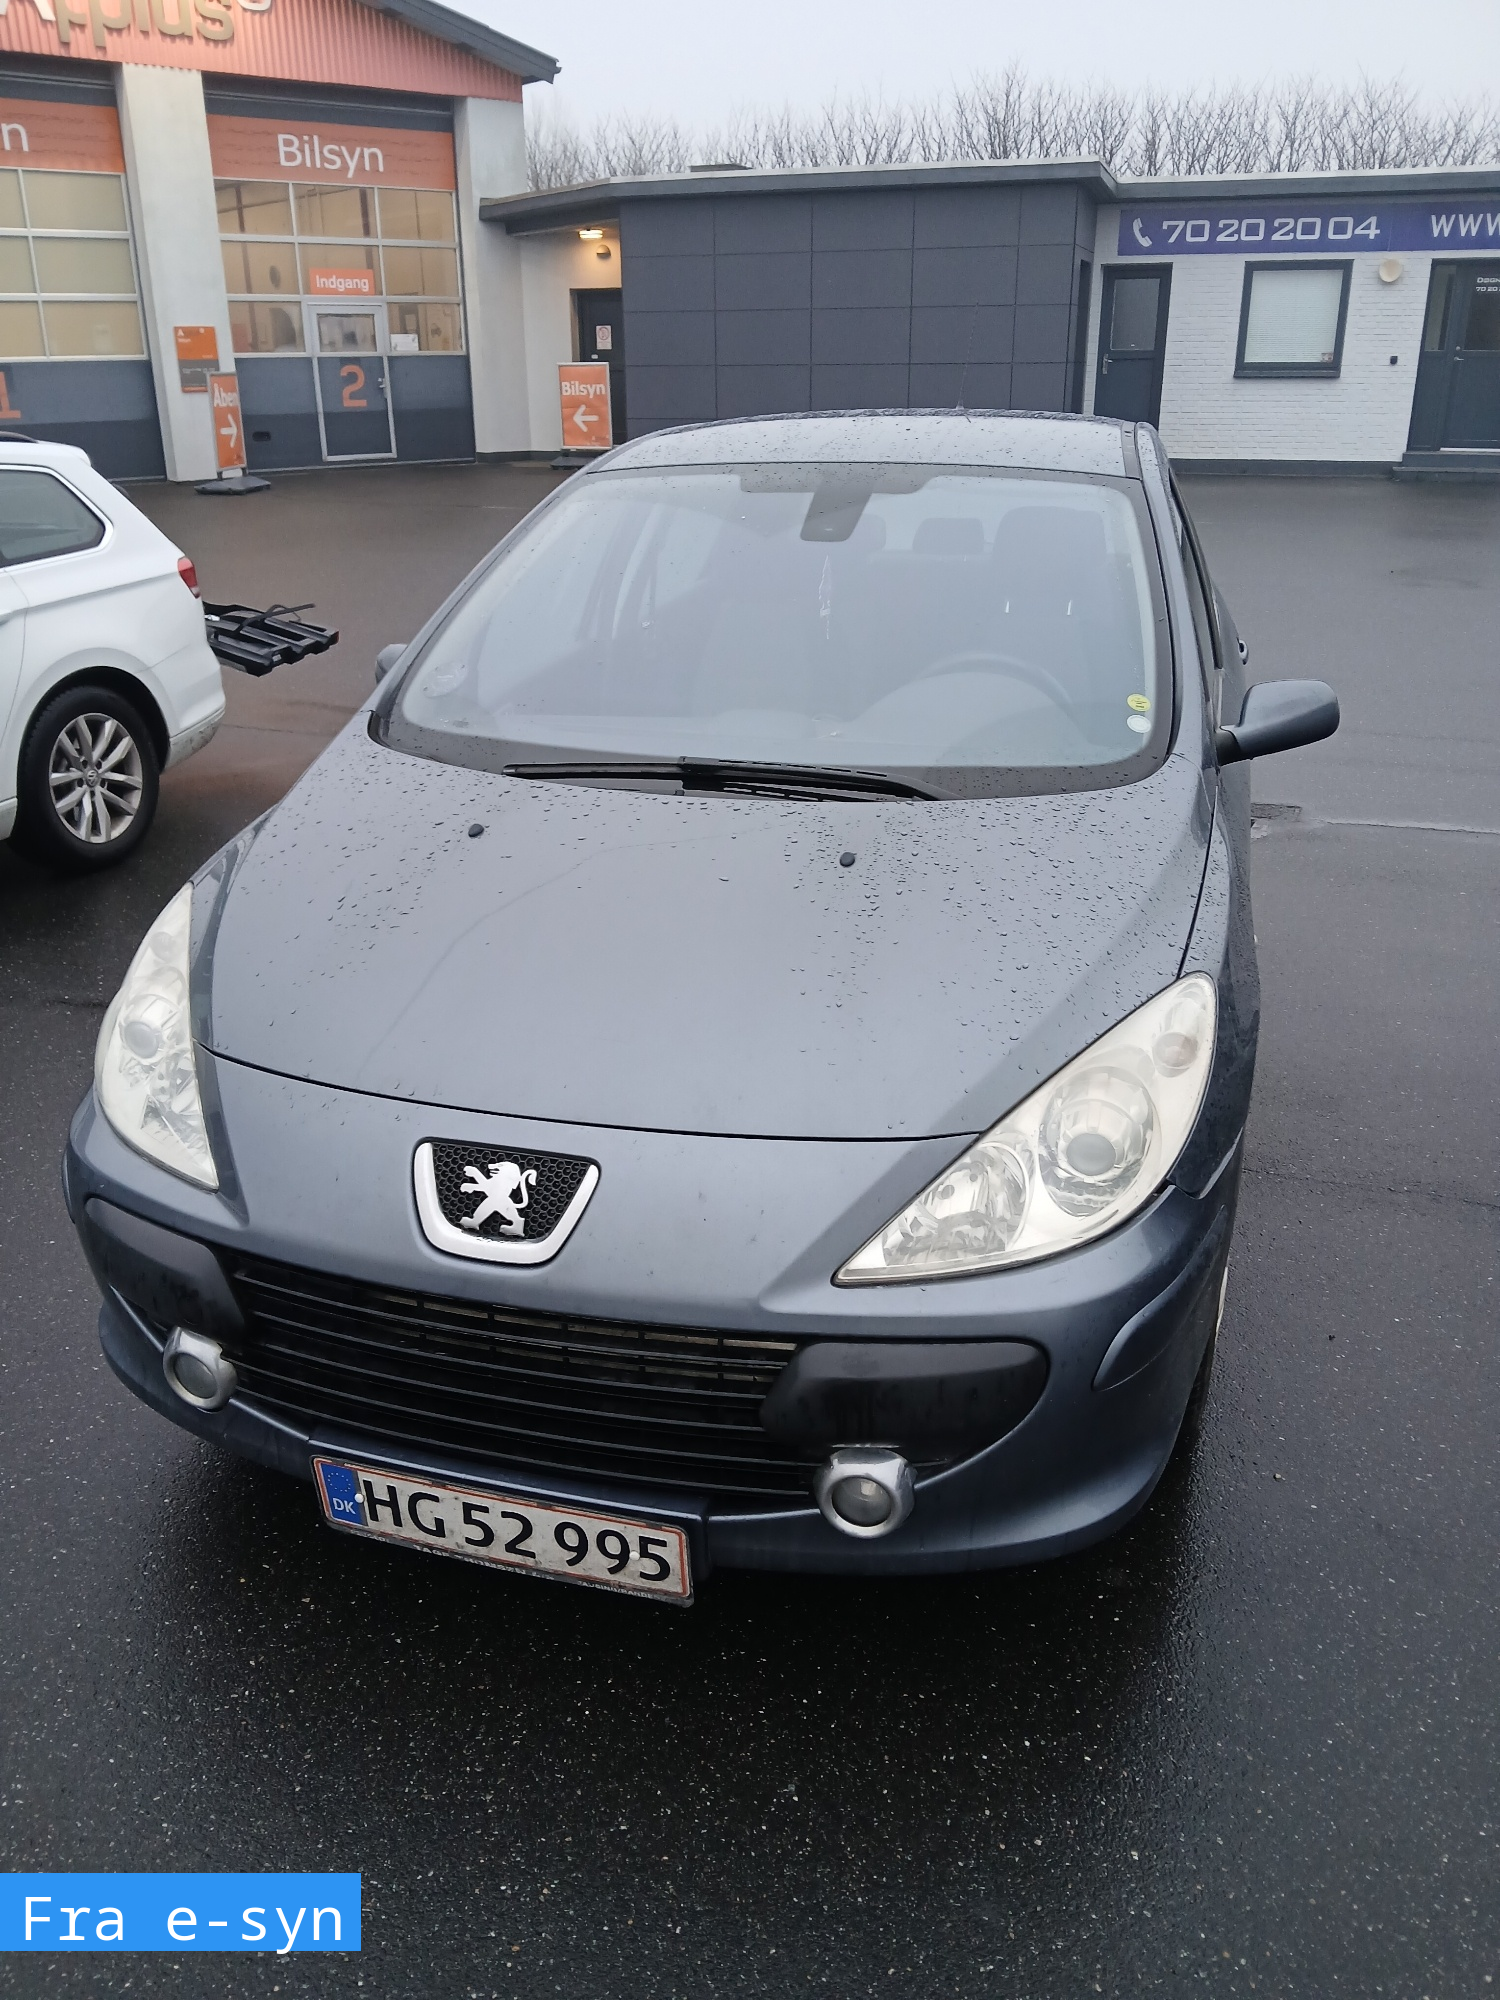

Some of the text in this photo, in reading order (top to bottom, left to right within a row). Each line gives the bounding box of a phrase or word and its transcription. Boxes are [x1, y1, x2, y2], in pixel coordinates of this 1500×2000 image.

[277, 133, 384, 178] Bilsyn
[1162, 216, 1381, 243] 70 20 20 04
[315, 274, 370, 292] Indgang
[340, 364, 368, 408] 2
[561, 381, 606, 398] Bilsyn
[333, 1497, 356, 1515] DK
[362, 1478, 671, 1582] HG 52 995
